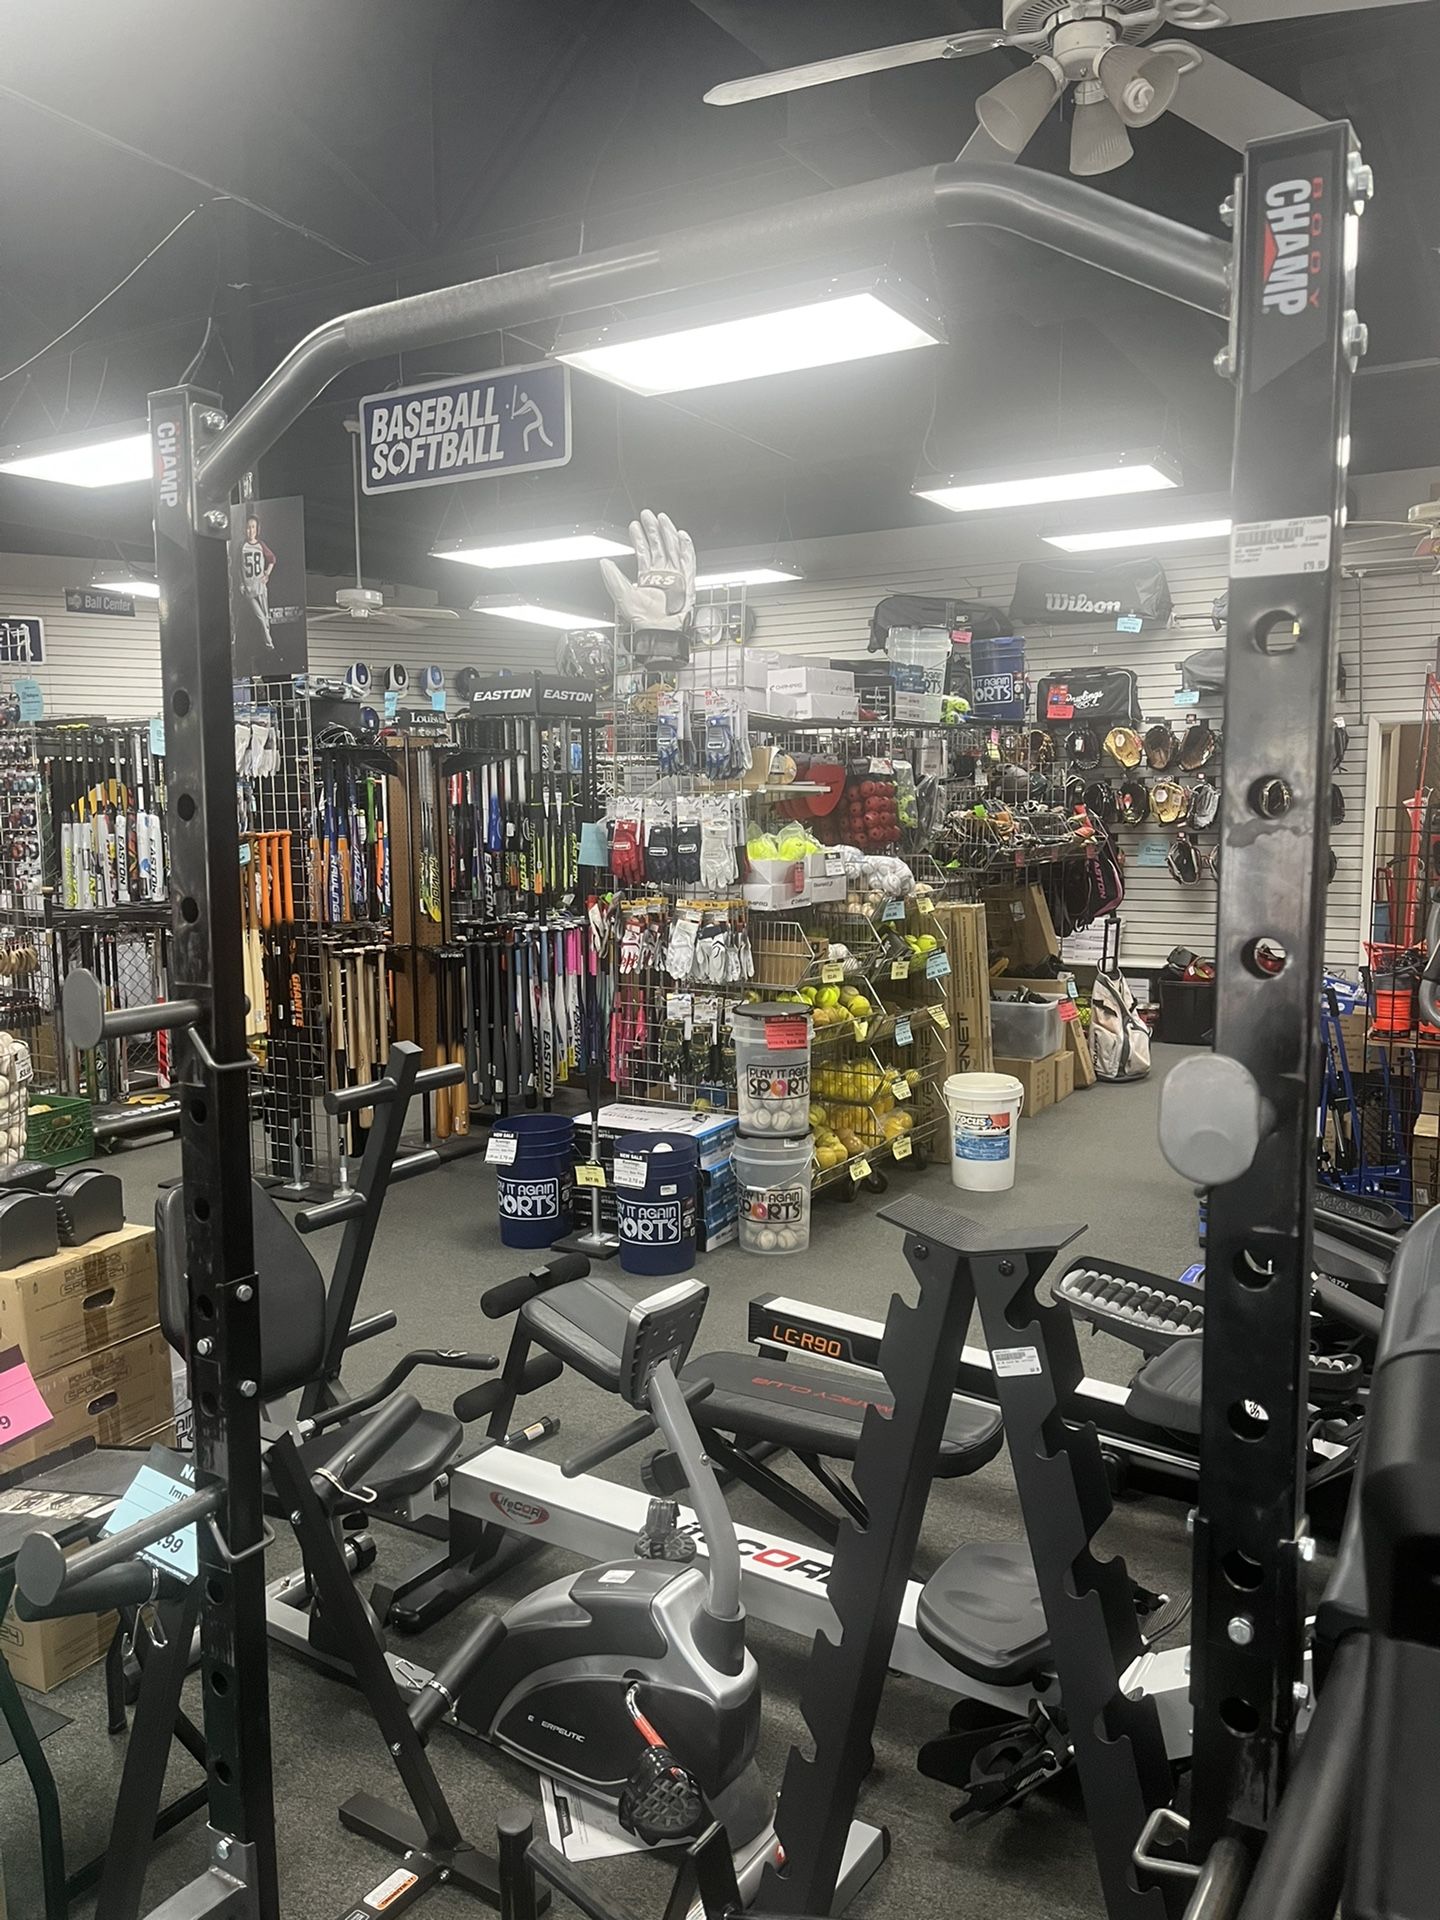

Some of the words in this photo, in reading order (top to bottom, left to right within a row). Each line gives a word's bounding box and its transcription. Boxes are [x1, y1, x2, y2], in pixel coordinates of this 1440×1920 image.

[1263, 179, 1312, 315] CHAMP
[371, 387, 499, 445] BASEBALL
[157, 422, 177, 507] CHAMP
[371, 423, 504, 480] SOFTBALL
[244, 552, 261, 577] 58
[85, 595, 101, 609] Ball
[104, 598, 131, 611] Center
[1045, 593, 1120, 613] Wilson
[974, 685, 1011, 701] ORTS
[984, 676, 1009, 686] AGAIN
[473, 688, 532, 702] EASTON
[543, 689, 593, 702] EASTON
[118, 836, 126, 884] EASTON
[149, 838, 158, 893] EASTON
[519, 852, 527, 890] STON
[330, 854, 340, 922] RAWLINGS
[483, 853, 495, 917] EASTON
[1094, 861, 1107, 898] ASTON
[291, 974, 304, 1028] GRANITE
[957, 1013, 970, 1072] RNET
[543, 1030, 552, 1093] EASTON
[750, 1068, 773, 1078] PLAY
[777, 1068, 787, 1078] IT
[956, 1115, 986, 1126] FOCUS
[506, 1184, 516, 1194] IT
[518, 1183, 554, 1195] AGAIN
[769, 1192, 800, 1202] AGAIN
[498, 1191, 556, 1216] ORTS
[626, 1205, 636, 1217] IT
[638, 1206, 676, 1219] AGAIN
[618, 1212, 678, 1240] ORTS
[156, 1534, 184, 1553] .99
